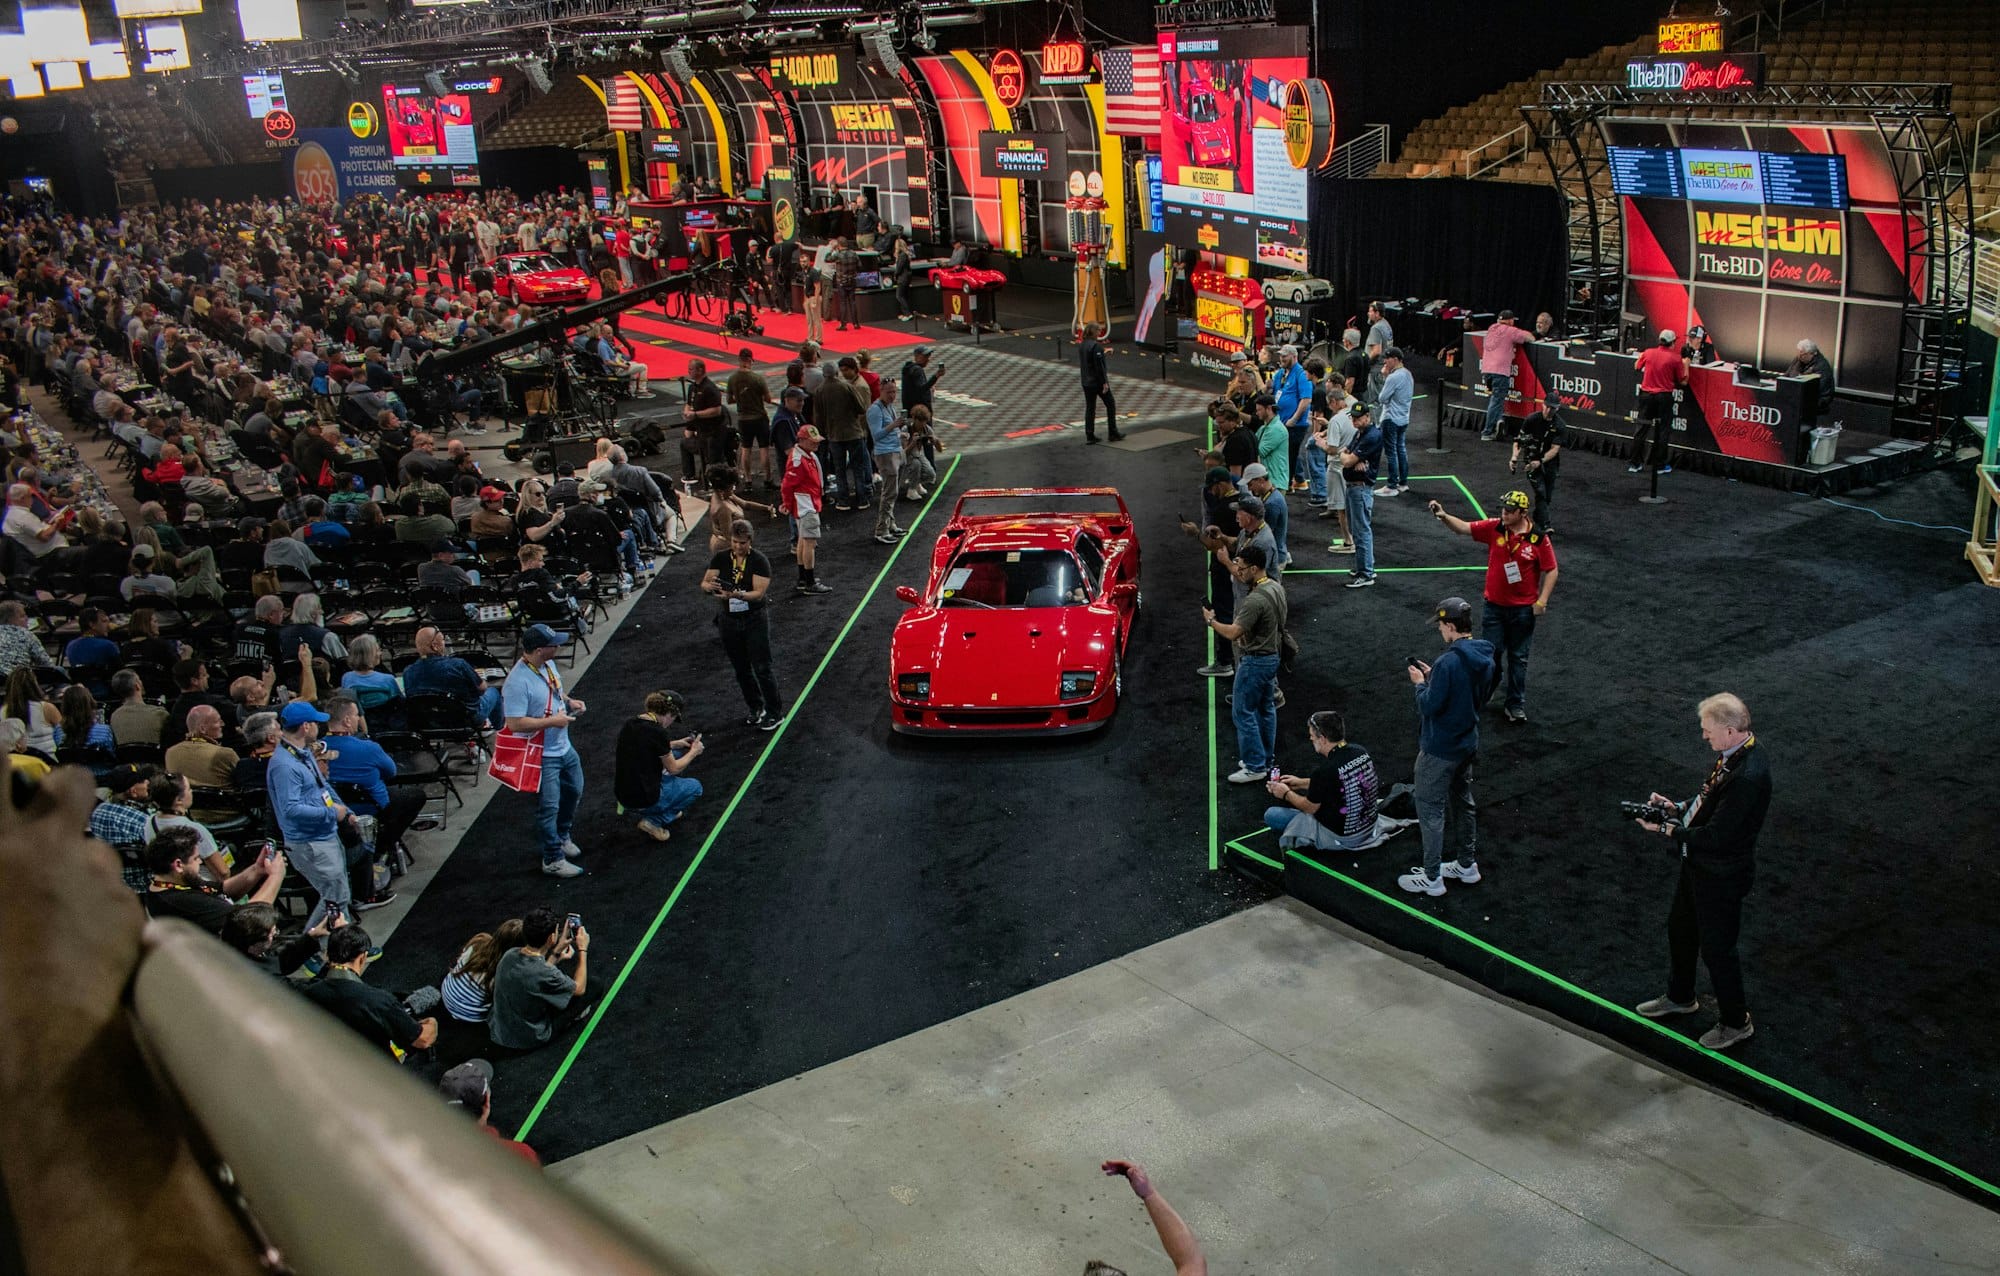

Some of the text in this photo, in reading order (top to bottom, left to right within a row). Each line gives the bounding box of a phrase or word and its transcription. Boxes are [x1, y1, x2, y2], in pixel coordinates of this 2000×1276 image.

[1658, 22, 1723, 53] MECUM
[1043, 44, 1084, 74] NPD
[782, 54, 838, 90] $400,000
[1682, 62, 1713, 90] Goes
[455, 82, 493, 91] DODGE
[267, 117, 291, 131] 303
[830, 104, 896, 130] MECUM
[837, 131, 897, 142] AUCTIONS
[349, 145, 386, 157] PREMIUM
[998, 152, 1046, 164] FINANCIAL
[341, 160, 396, 172] PROTECTANT
[1688, 161, 1753, 179] MECUM
[299, 169, 334, 198] 303
[353, 174, 396, 187] CLEANERS
[1200, 172, 1219, 186] RESERVE
[1260, 220, 1289, 231] DODGE
[1696, 211, 1841, 255] MECUM
[1770, 257, 1803, 280] Goes
[1274, 306, 1300, 317] CURING
[1717, 420, 1747, 439] Goes
